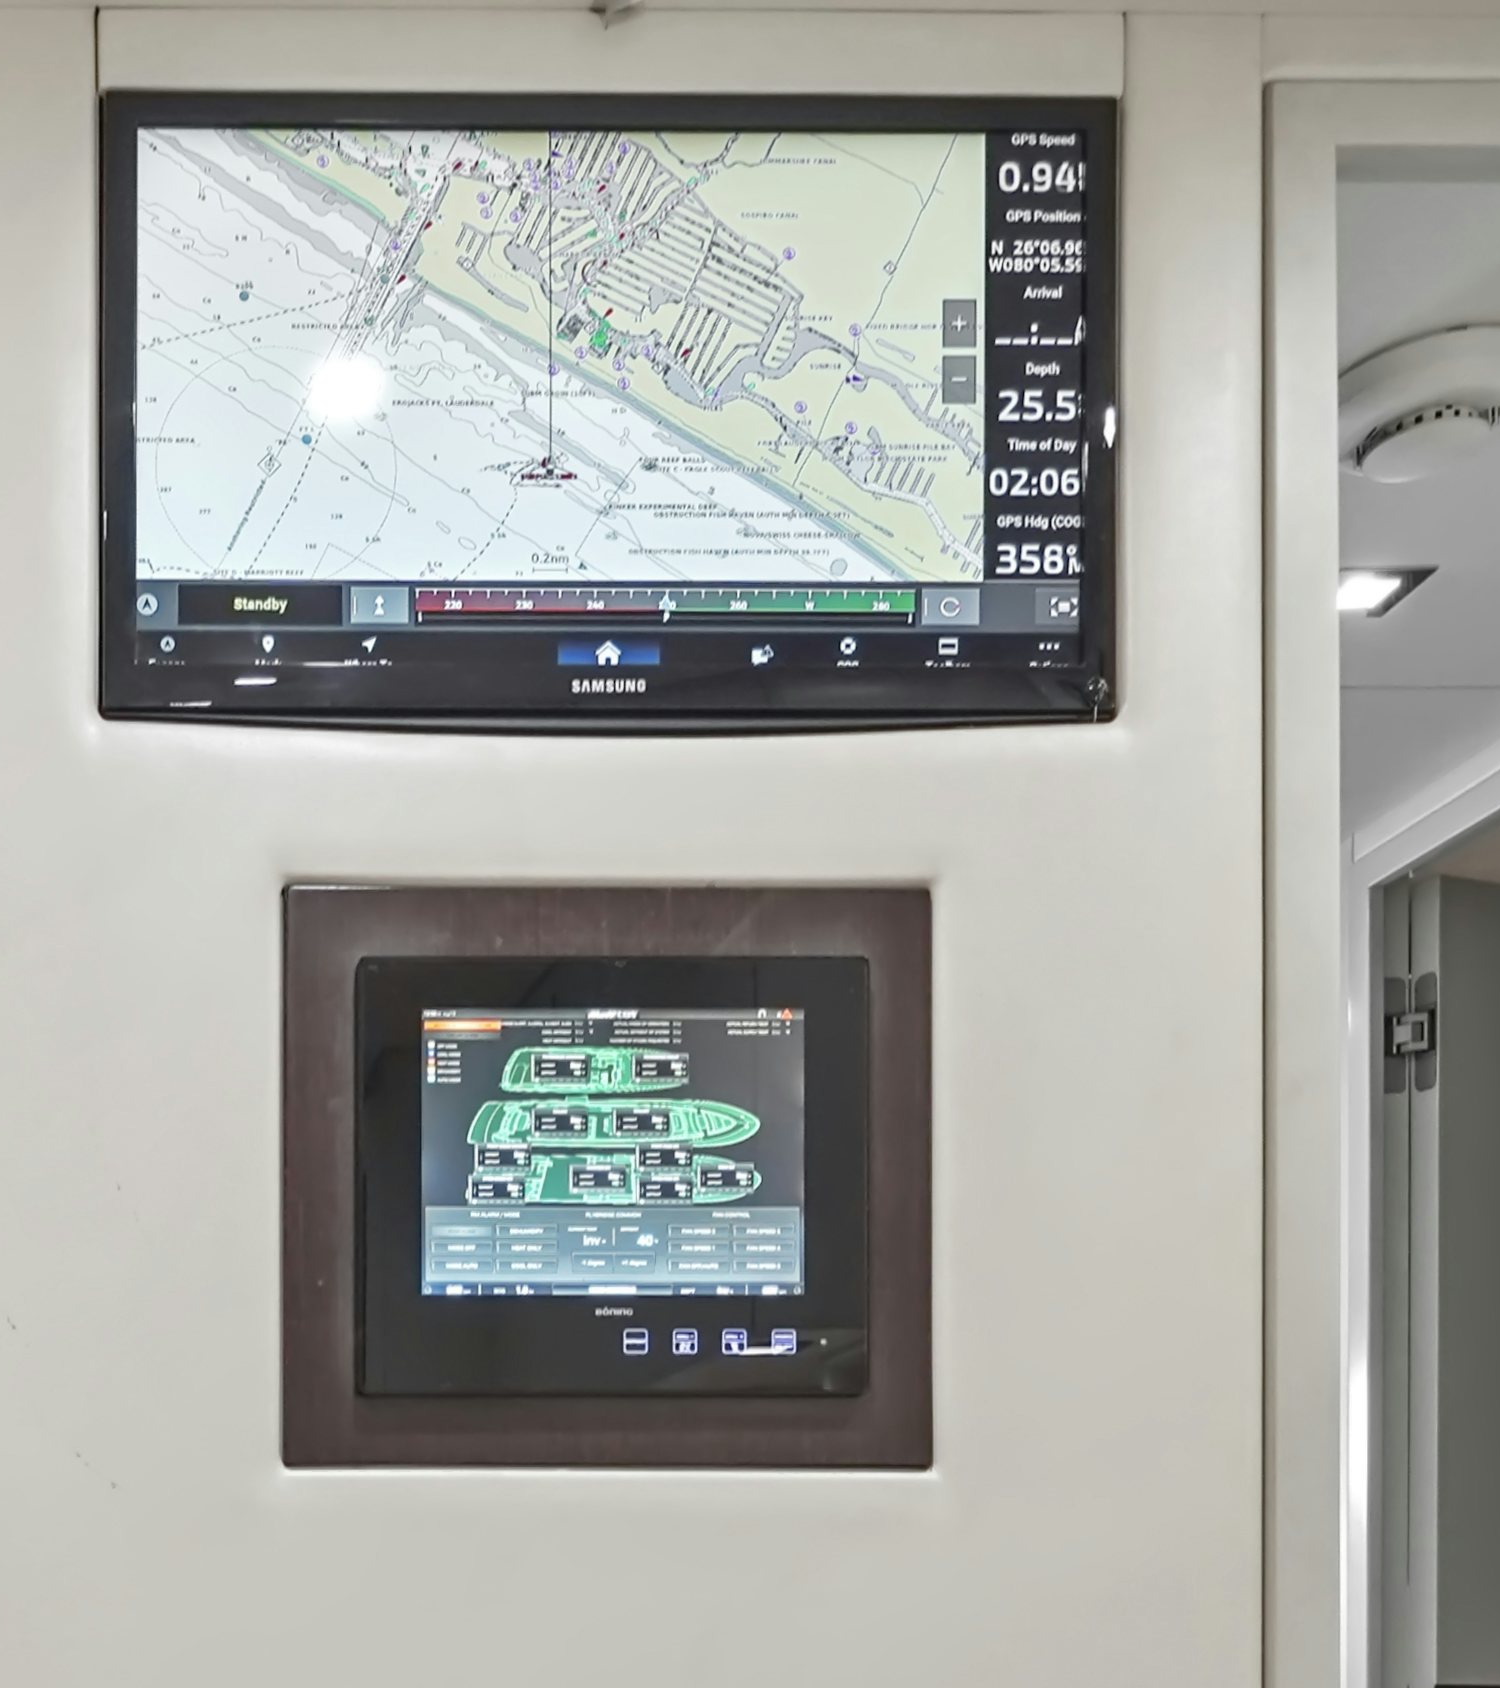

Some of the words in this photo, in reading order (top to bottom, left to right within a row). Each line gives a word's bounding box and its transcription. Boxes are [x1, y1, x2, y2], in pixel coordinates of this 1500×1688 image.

[1012, 133, 1036, 145] GPS
[1039, 134, 1075, 148] Speed
[1006, 210, 1031, 222] GPS
[1034, 210, 1081, 222] Position
[992, 240, 1003, 255] N
[1024, 286, 1062, 298] Arrival
[1026, 362, 1060, 377] Depth
[999, 390, 1076, 421] 25.5
[1008, 438, 1037, 451] Time
[1039, 438, 1052, 451] of
[1054, 438, 1076, 454] Day
[990, 468, 1079, 496] 02:06
[997, 515, 1022, 528] GPS
[1025, 515, 1049, 530] Hdg
[234, 597, 287, 614] Standby
[572, 679, 646, 693] SAMSUNG
